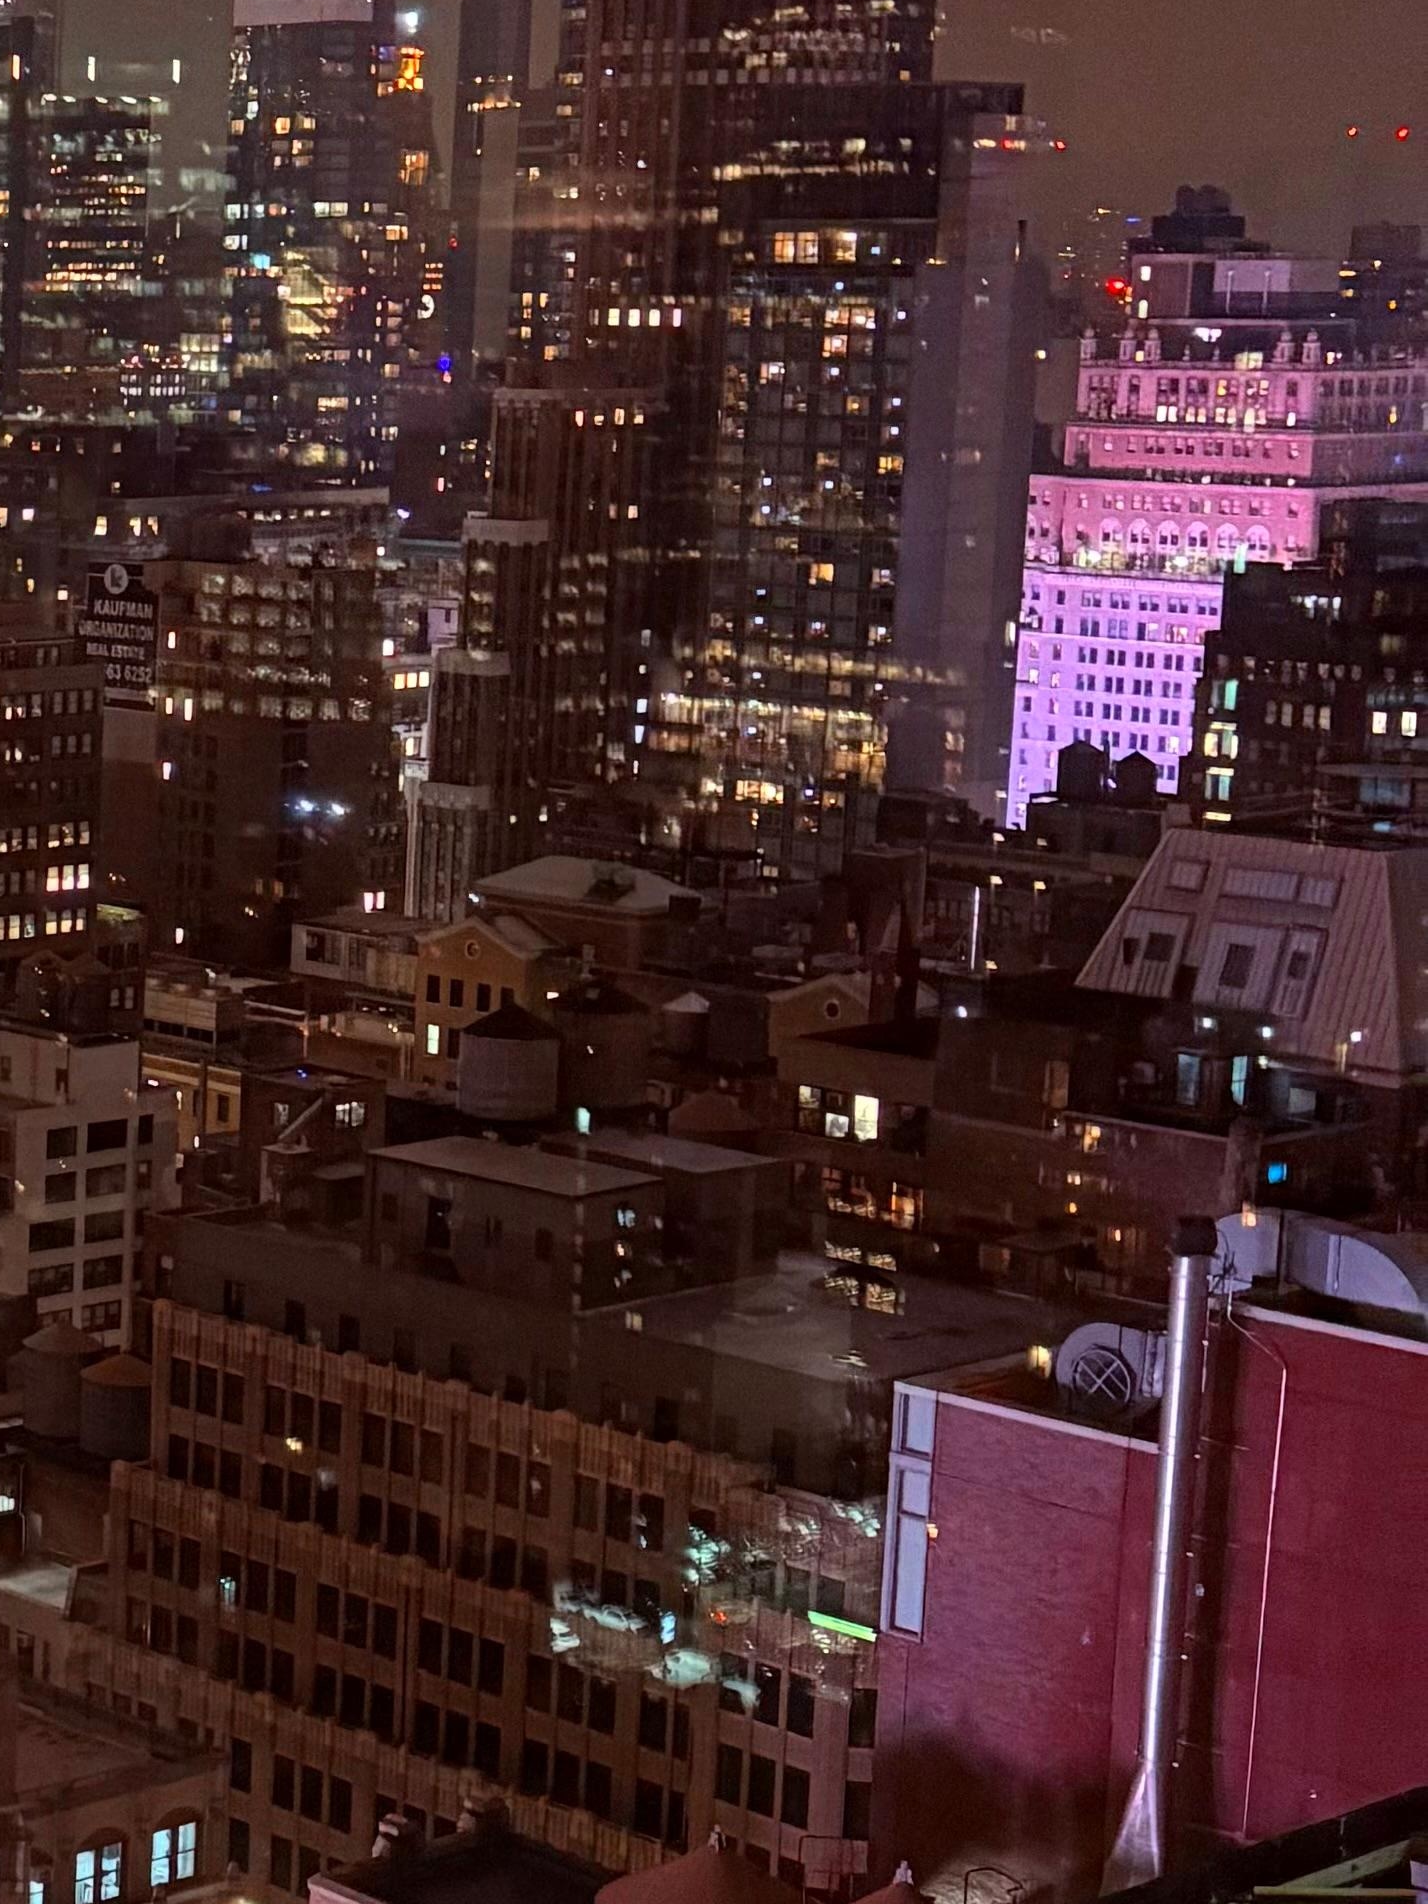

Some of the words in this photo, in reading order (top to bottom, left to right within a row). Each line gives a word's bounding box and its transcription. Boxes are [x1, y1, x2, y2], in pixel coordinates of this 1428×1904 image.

[93, 599, 153, 620] KAUFMAN
[78, 619, 154, 641] ORGANIZATION
[86, 642, 109, 657] REAL
[111, 644, 145, 661] ESTATE
[104, 663, 121, 680] 63
[124, 665, 153, 684] 6252
